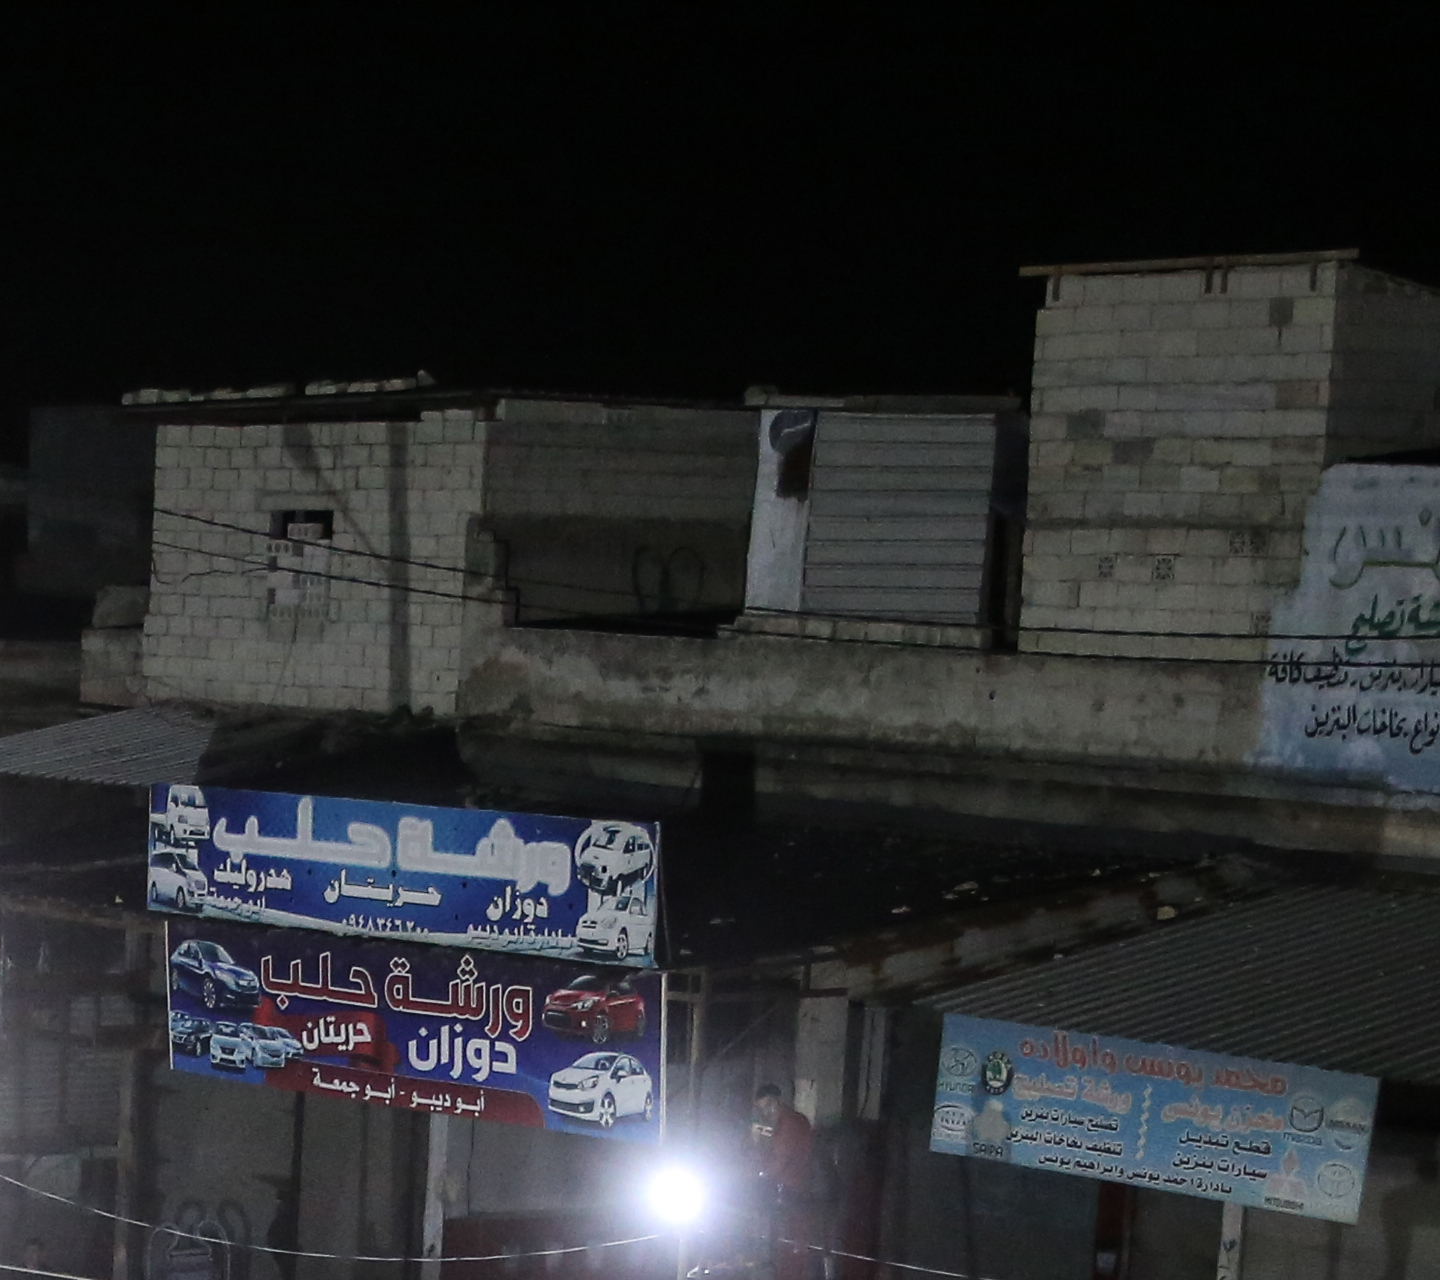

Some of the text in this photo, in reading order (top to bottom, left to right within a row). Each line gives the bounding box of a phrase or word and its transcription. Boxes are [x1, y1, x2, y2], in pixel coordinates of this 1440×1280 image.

[213, 796, 392, 868] حلب
[322, 868, 441, 907] حريتان
[485, 885, 548, 923] دوزان
[260, 951, 534, 1042] ورشة حلب
[301, 1014, 518, 1082] دوزان حريتان
[311, 1066, 486, 1117] أبو ديبو أبو جمعة
[1171, 1151, 1216, 1174] بنزين
[1177, 1130, 1231, 1155] تبديل
